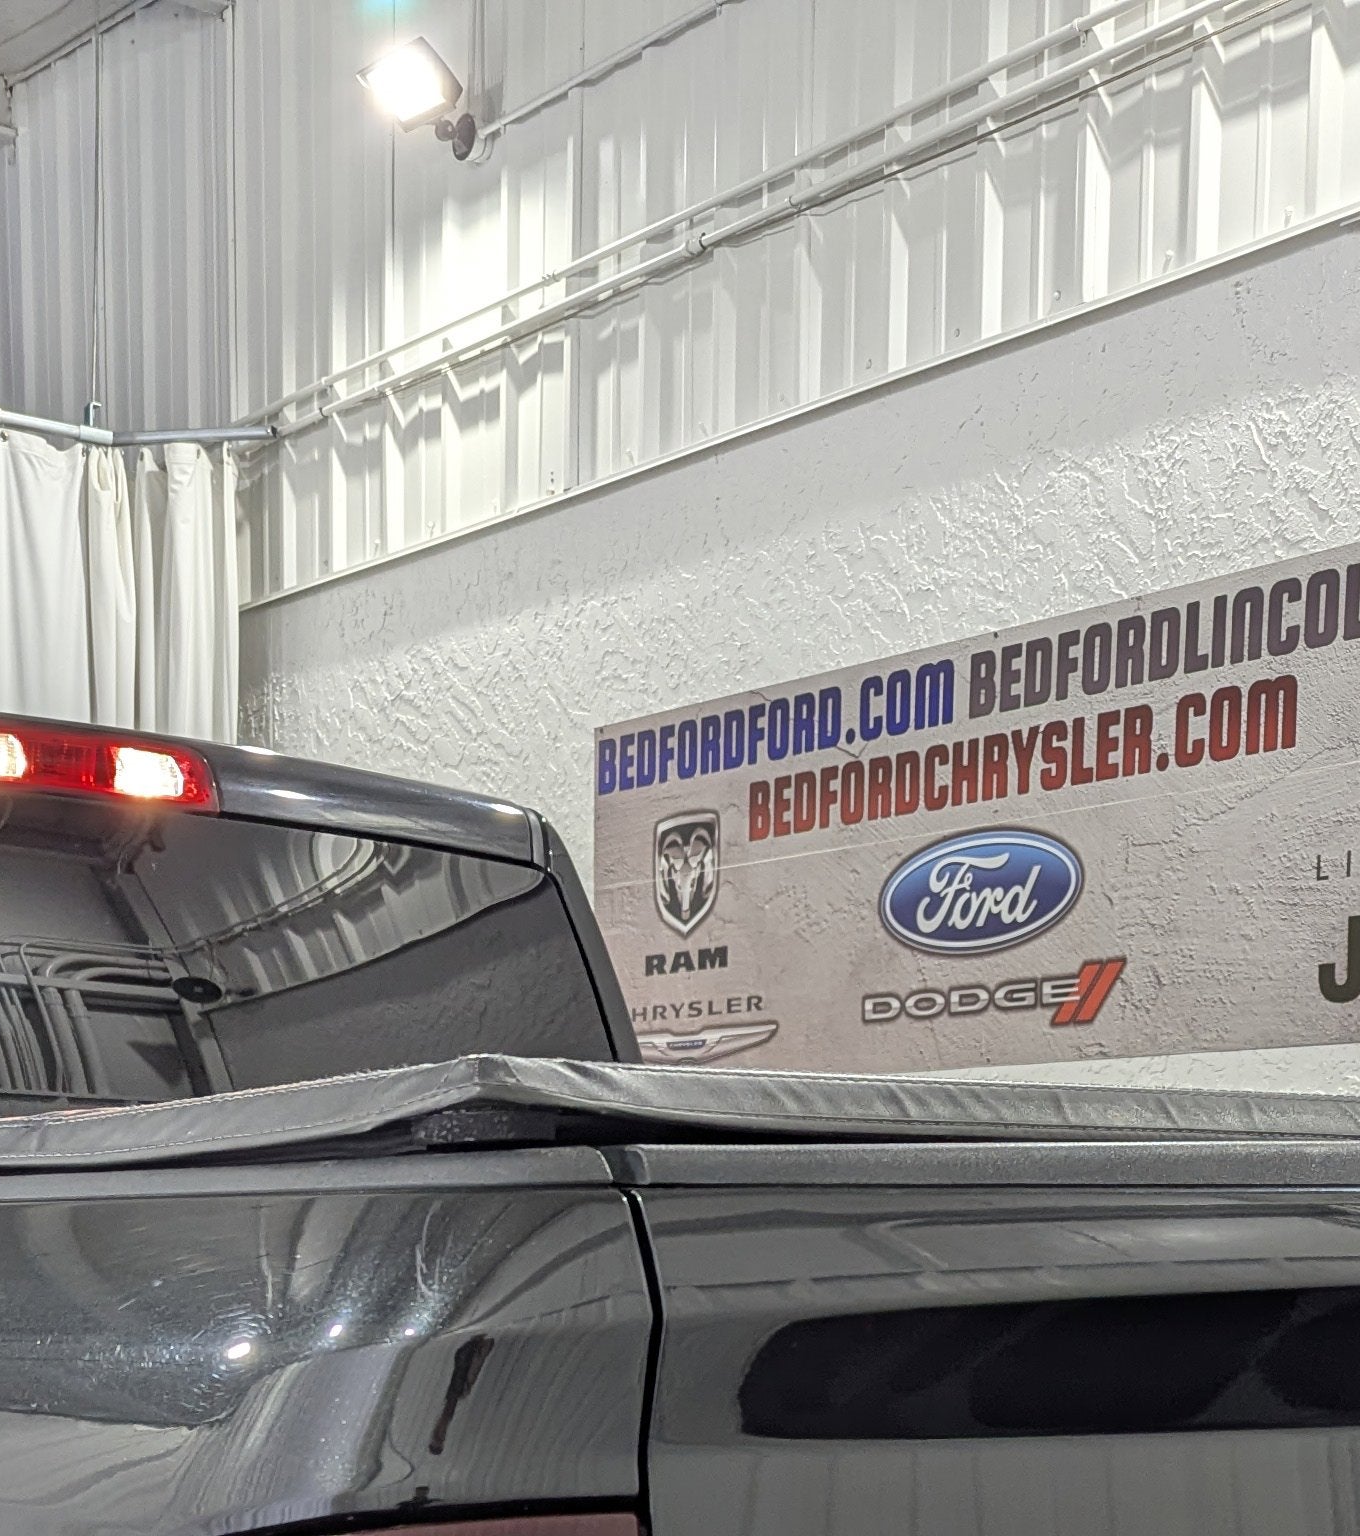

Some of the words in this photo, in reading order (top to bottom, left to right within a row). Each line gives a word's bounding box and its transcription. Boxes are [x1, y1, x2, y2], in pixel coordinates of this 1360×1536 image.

[598, 658, 955, 796] BEDFORDFORD.COM
[748, 674, 1298, 842] BEDFORDCHRYSLER.COM
[915, 852, 1042, 934] Ford
[644, 945, 729, 977] RAM
[630, 995, 764, 1023] HRYSLER
[862, 975, 1081, 1023] DODGE
